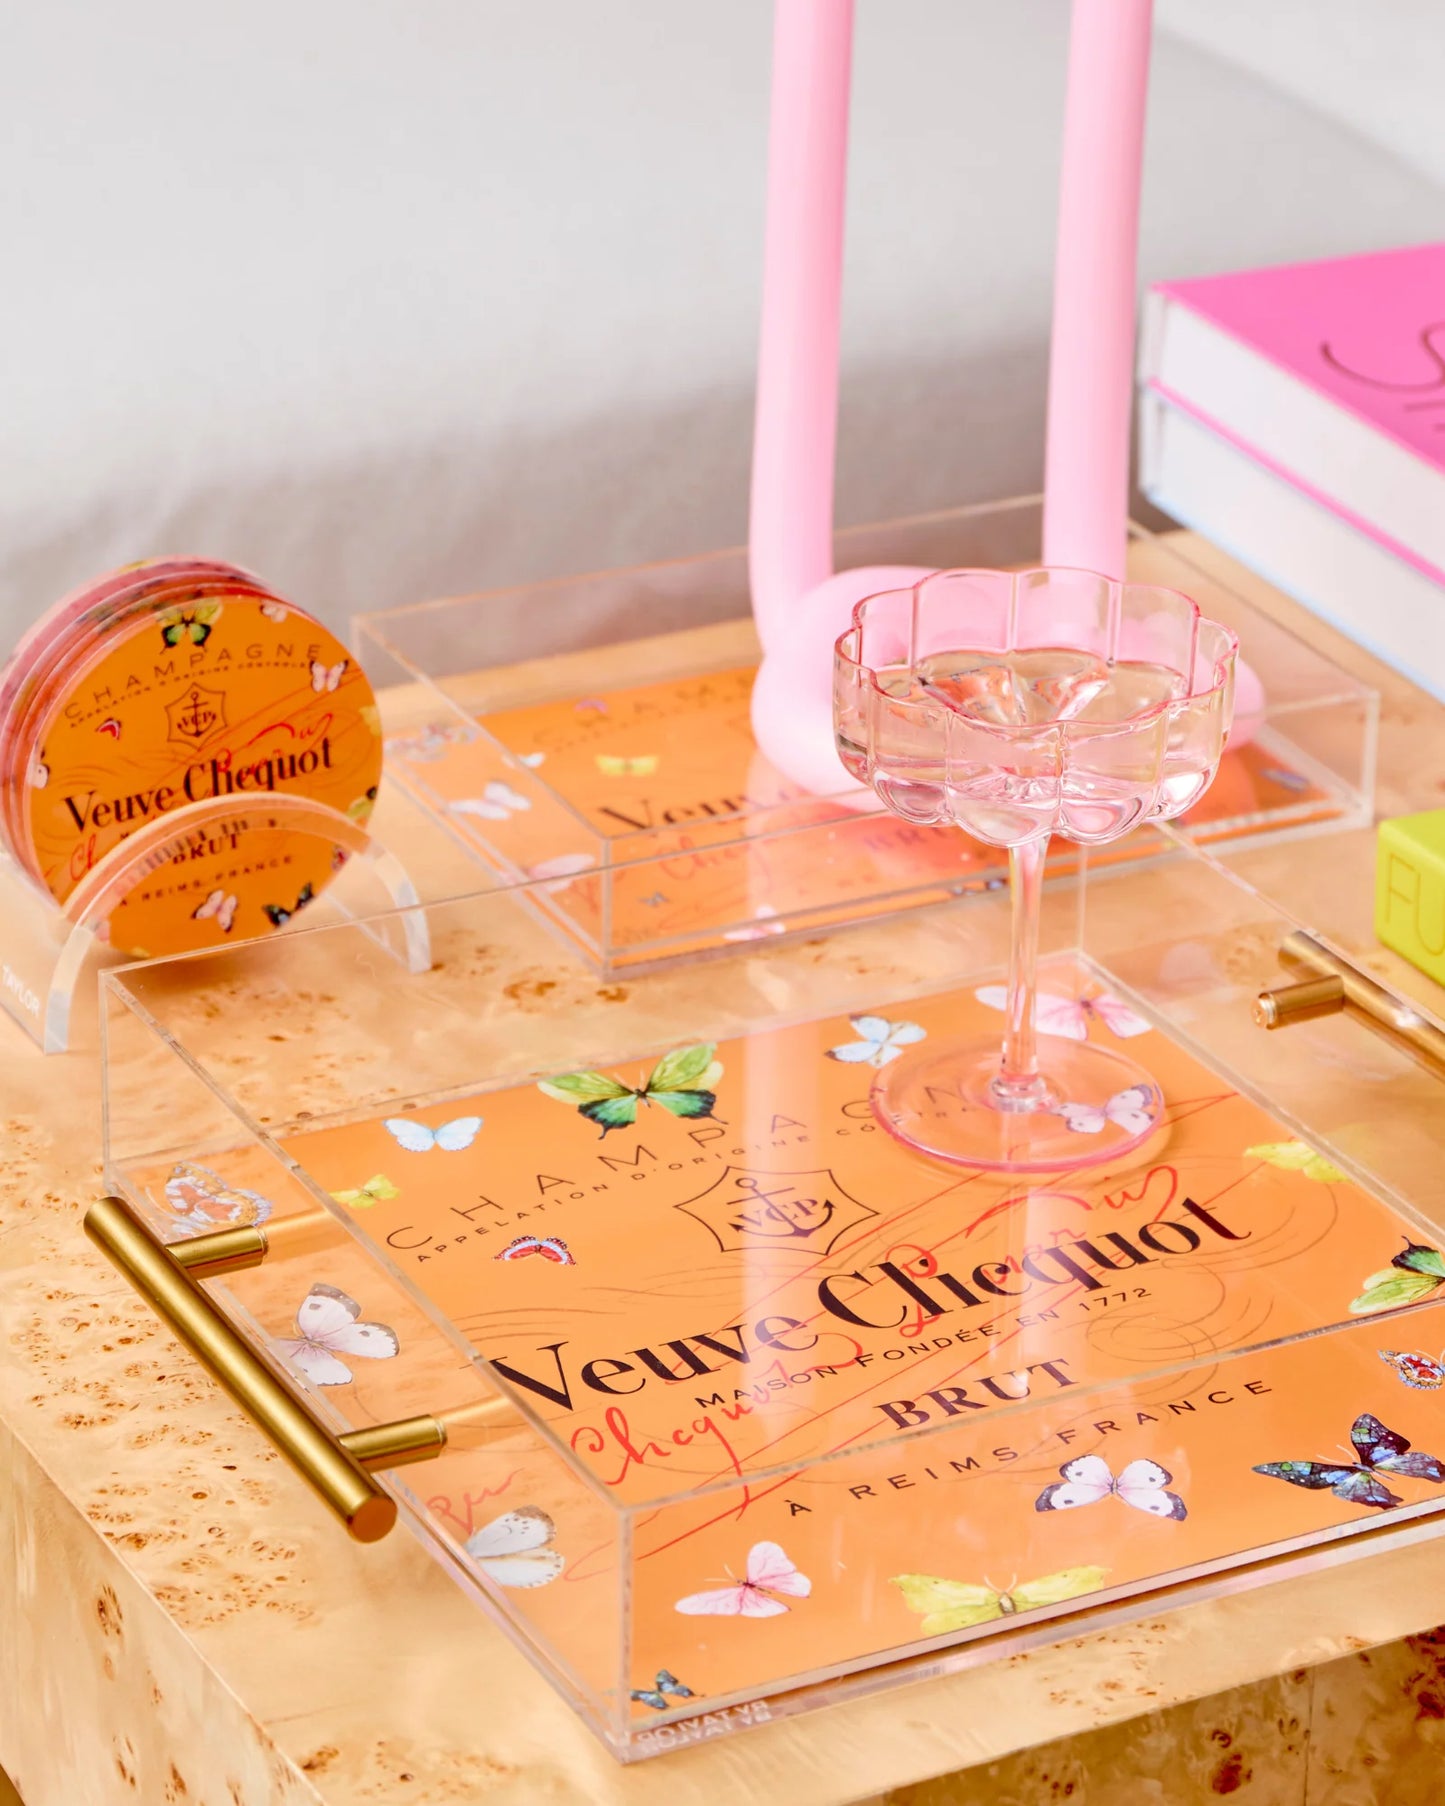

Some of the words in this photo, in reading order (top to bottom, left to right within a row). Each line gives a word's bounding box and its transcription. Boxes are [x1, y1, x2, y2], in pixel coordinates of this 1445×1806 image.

[65, 643, 321, 719] CHAMPAGNE
[65, 787, 174, 833] Veuve
[417, 1183, 609, 1262] APPELATION
[736, 1198, 819, 1229] VCP
[489, 1316, 818, 1411] Veuve
[818, 1197, 1251, 1329] Clicquot
[695, 1366, 838, 1408] MAISON
[855, 1324, 1000, 1367] FONDÉE
[1016, 1309, 1060, 1328] EN
[1079, 1287, 1152, 1312] 1772
[873, 1358, 1080, 1430] BRUT
[848, 1446, 1019, 1499] REIMS
[1057, 1380, 1272, 1444] FRANCE
